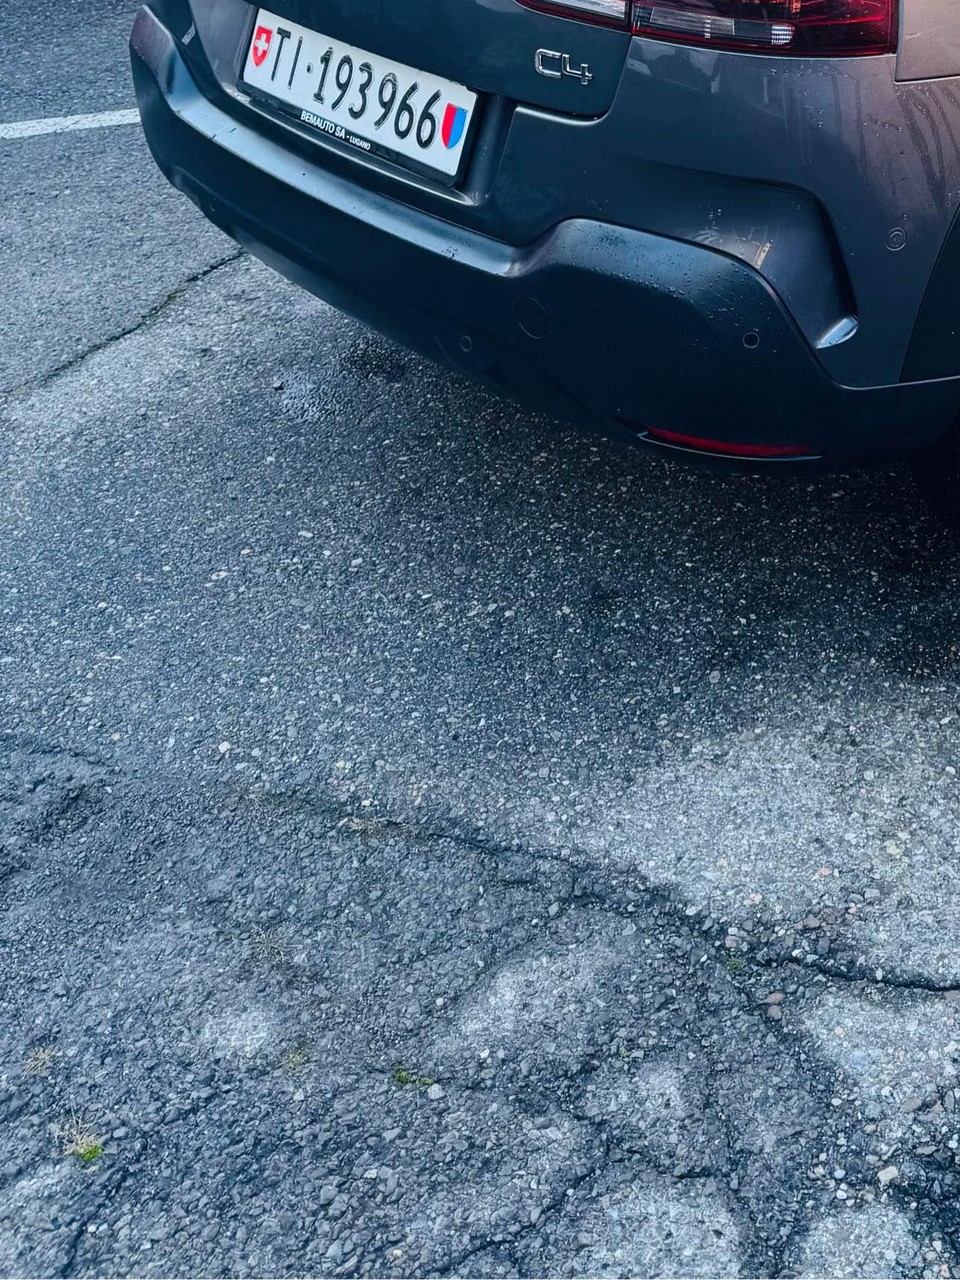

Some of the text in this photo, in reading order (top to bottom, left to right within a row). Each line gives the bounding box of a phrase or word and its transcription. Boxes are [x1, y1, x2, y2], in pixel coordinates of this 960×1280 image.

[534, 48, 593, 84] C4
[300, 110, 335, 134] BEMAUTO
[335, 124, 345, 140] SA
[350, 135, 371, 150] LUGANO
